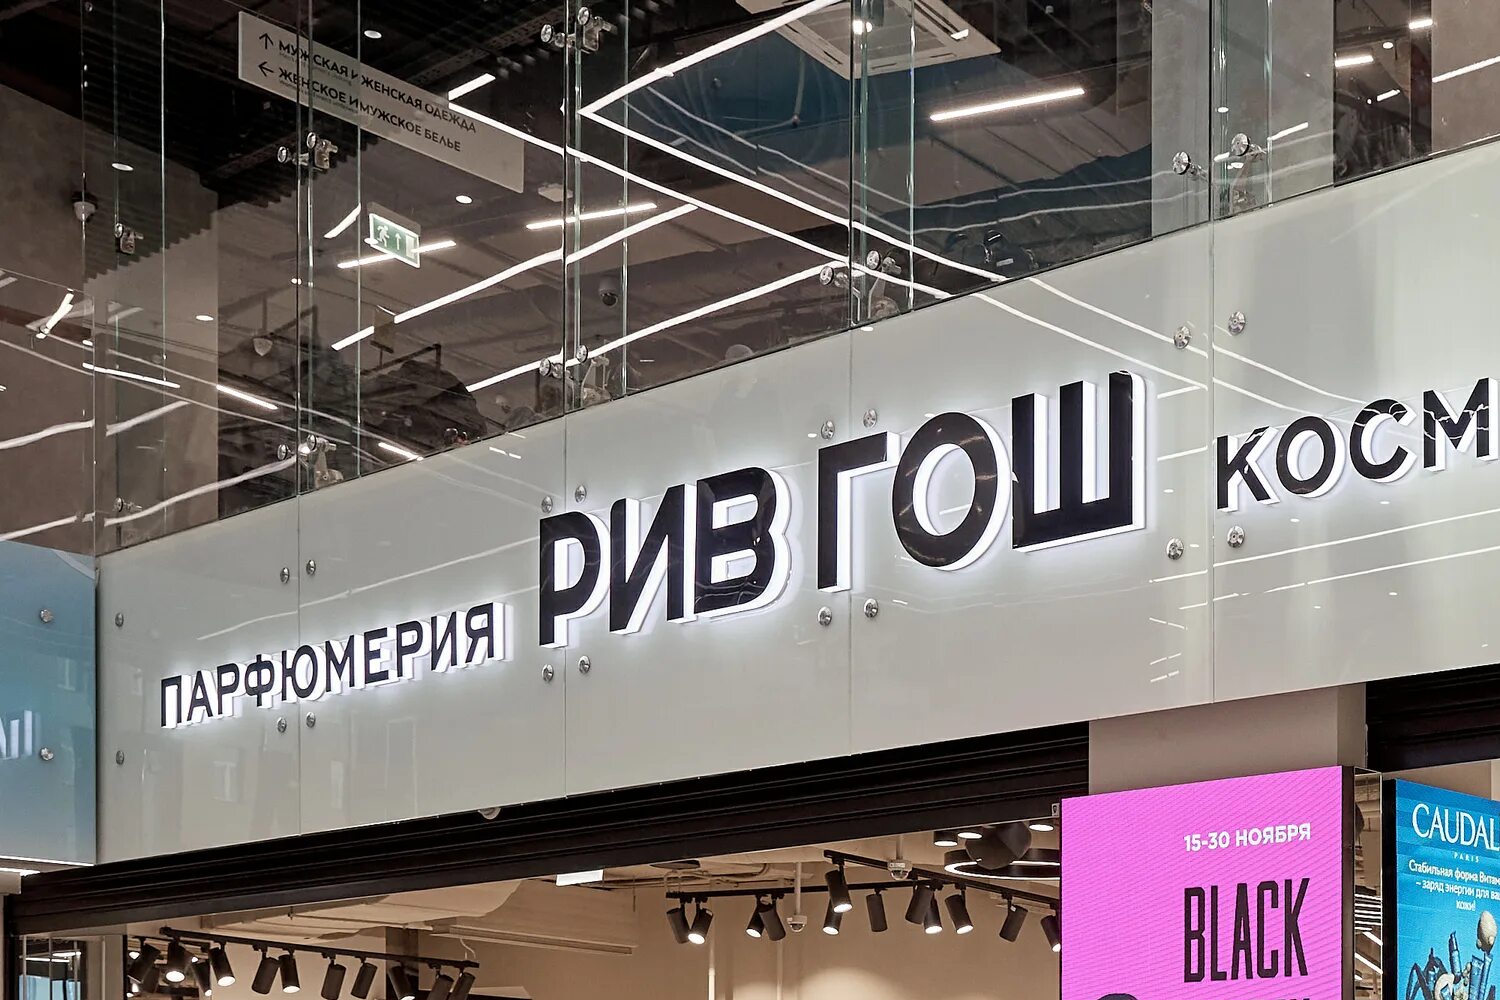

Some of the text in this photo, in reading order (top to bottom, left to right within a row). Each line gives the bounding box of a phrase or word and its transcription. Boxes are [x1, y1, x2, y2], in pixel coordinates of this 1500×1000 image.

[278, 40, 348, 80] МУЖСКАЯ
[361, 78, 422, 108] ЖЕНСКАЯ
[425, 104, 476, 134] ОДЕЖДА
[279, 67, 346, 104] ЖЕНСКОЕ
[359, 104, 422, 136] МУЖСКОЕ
[424, 129, 462, 152] БЕЛЬЕ
[160, 602, 503, 728] ПАРФЮМЕРИЯ
[539, 467, 787, 648] РИВ
[816, 370, 1145, 592] ГОШ
[1184, 822, 1311, 852] 15-30 НОЯБРЯ
[1453, 852, 1480, 863] PARIS
[1408, 860, 1453, 880] Стабильная
[1454, 868, 1479, 883] форма
[1422, 879, 1445, 893] заряд
[1445, 884, 1475, 897] энергии
[1476, 888, 1490, 900] для
[1184, 878, 1310, 983] BLACK
